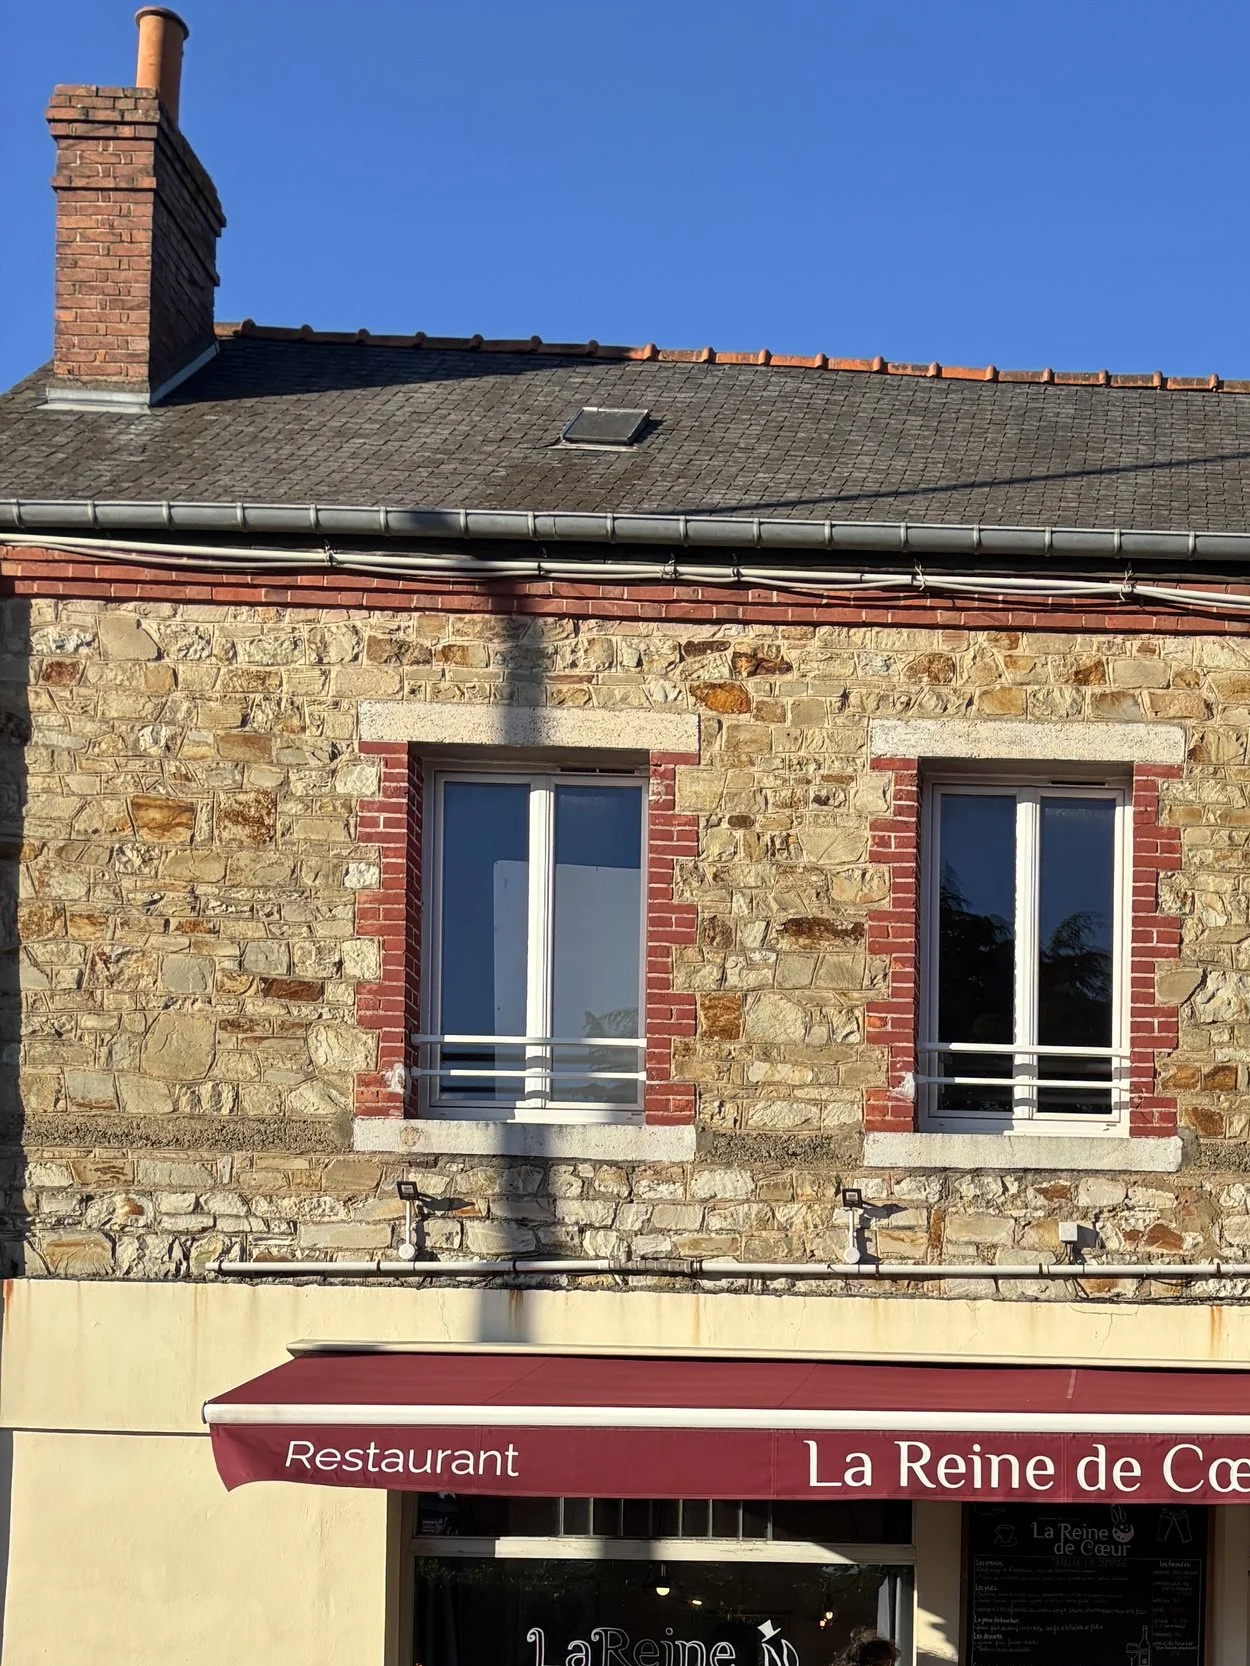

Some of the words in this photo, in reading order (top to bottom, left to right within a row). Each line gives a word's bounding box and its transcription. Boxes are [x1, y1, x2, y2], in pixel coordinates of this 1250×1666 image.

[284, 1440, 520, 1478] Restaurant
[803, 1440, 872, 1488] La
[893, 1441, 1055, 1490] Reine
[1076, 1443, 1142, 1493] de
[1030, 1521, 1054, 1539] La
[1057, 1522, 1109, 1541] Reine
[1053, 1539, 1075, 1556] de
